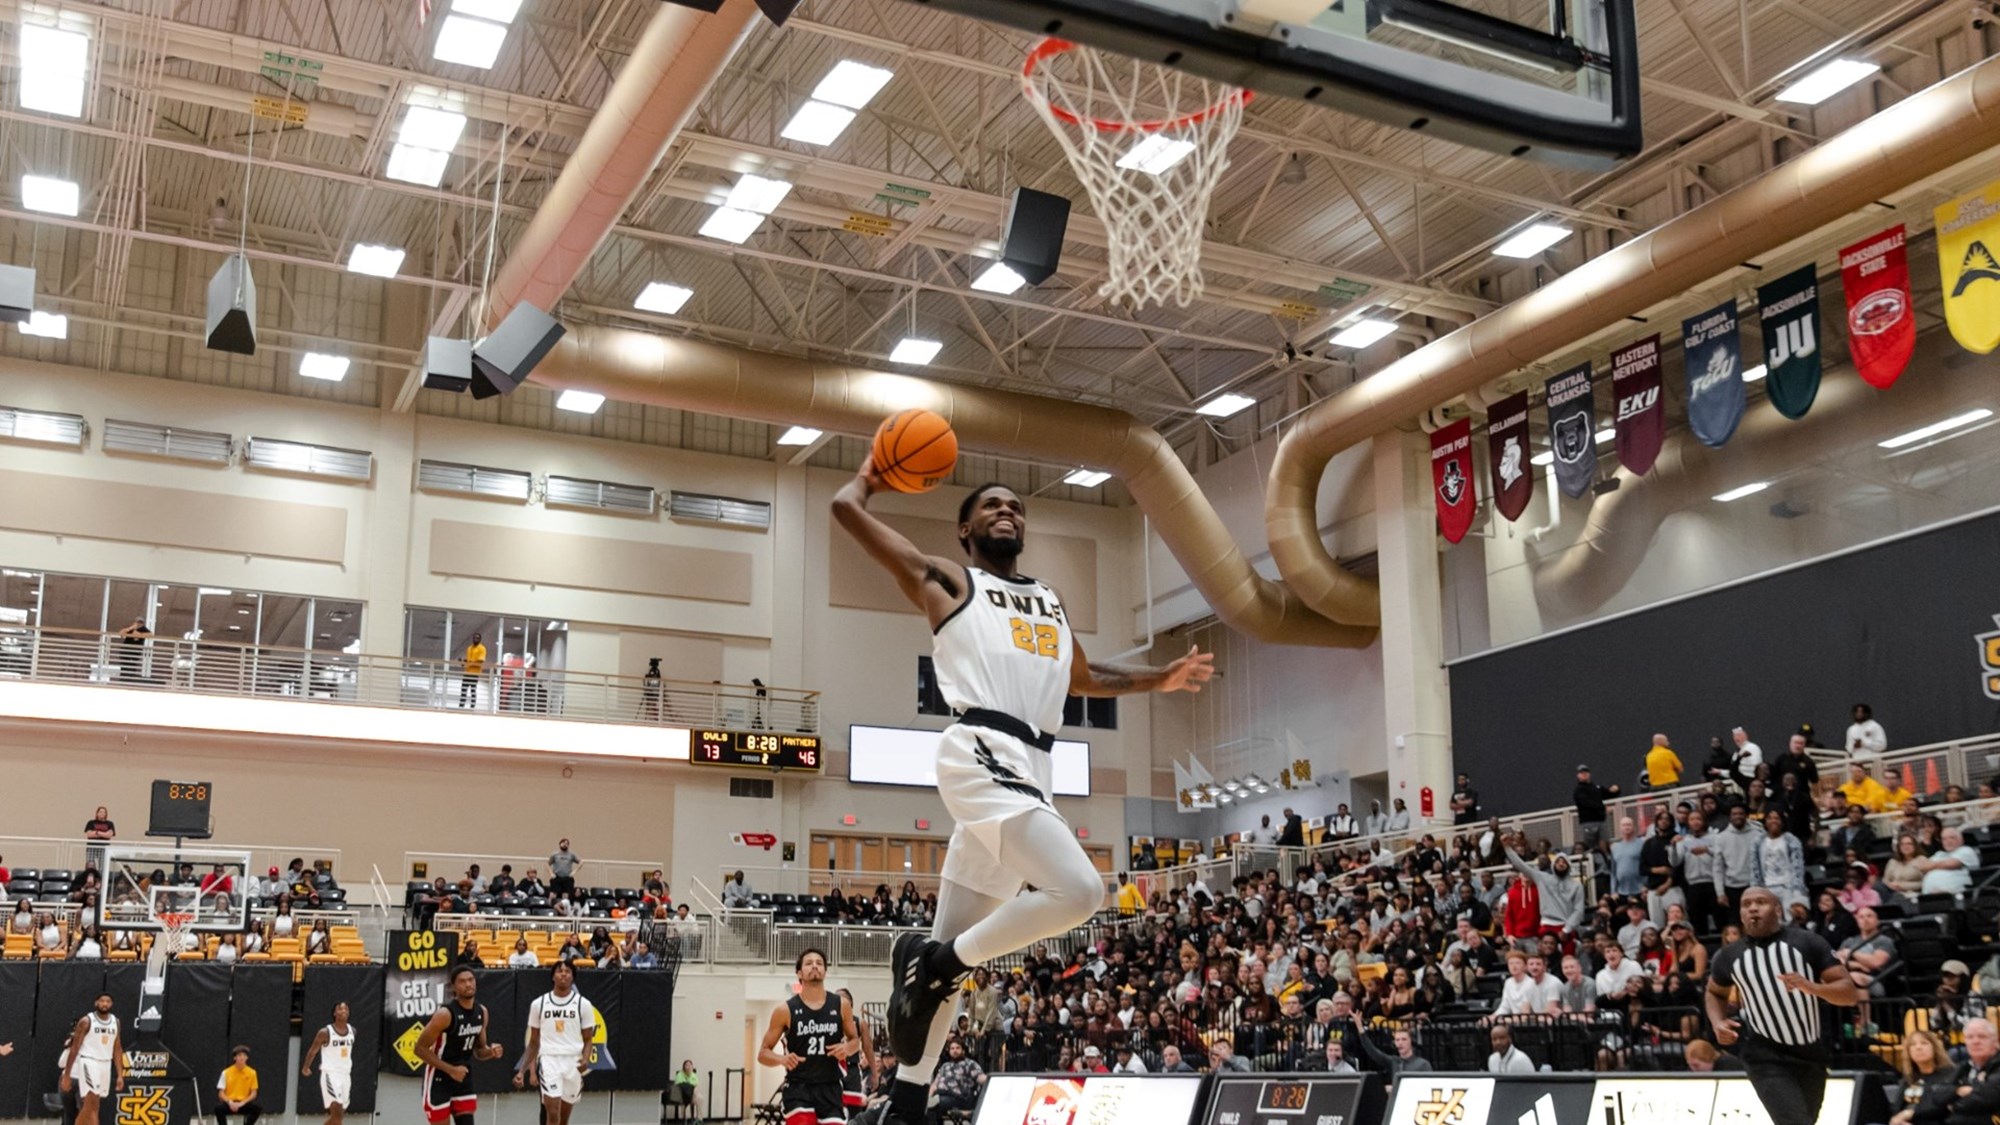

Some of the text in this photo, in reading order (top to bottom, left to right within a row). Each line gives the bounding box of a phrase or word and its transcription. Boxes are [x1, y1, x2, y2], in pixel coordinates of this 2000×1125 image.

[1841, 232, 1905, 270] JACKSONVILLE
[1859, 255, 1887, 277] STATE
[1761, 285, 1816, 320] JACKSONVILLE
[1685, 319, 1736, 348] GULF COAST
[1691, 311, 1728, 335] FLORIDA
[1769, 313, 1816, 370] JU
[1615, 341, 1656, 368] EASTERN
[1613, 353, 1659, 381] KENTUCKY
[1550, 371, 1586, 395] CENTRAL
[1547, 381, 1591, 408] ARKANSAS
[1618, 385, 1660, 417] EKU
[1489, 410, 1528, 435] BELLARMINE
[1432, 443, 1453, 460] AUSTIN
[1009, 616, 1060, 661] 22
[703, 732, 728, 742] OWLS
[746, 735, 778, 751] 8:28
[782, 737, 816, 748] PANTHERS
[703, 744, 720, 760] 73
[761, 753, 769, 765] 2
[798, 751, 816, 766] 46
[169, 784, 207, 801] 8:28
[408, 930, 435, 951] GO
[398, 947, 448, 972] OWLS
[400, 979, 429, 999] GET
[544, 1010, 576, 1019] OWLS
[94, 1027, 115, 1035] OWLS
[807, 1036, 826, 1056] 21
[1271, 1087, 1306, 1108] 8:28
[1220, 1112, 1241, 1125] OWLS
